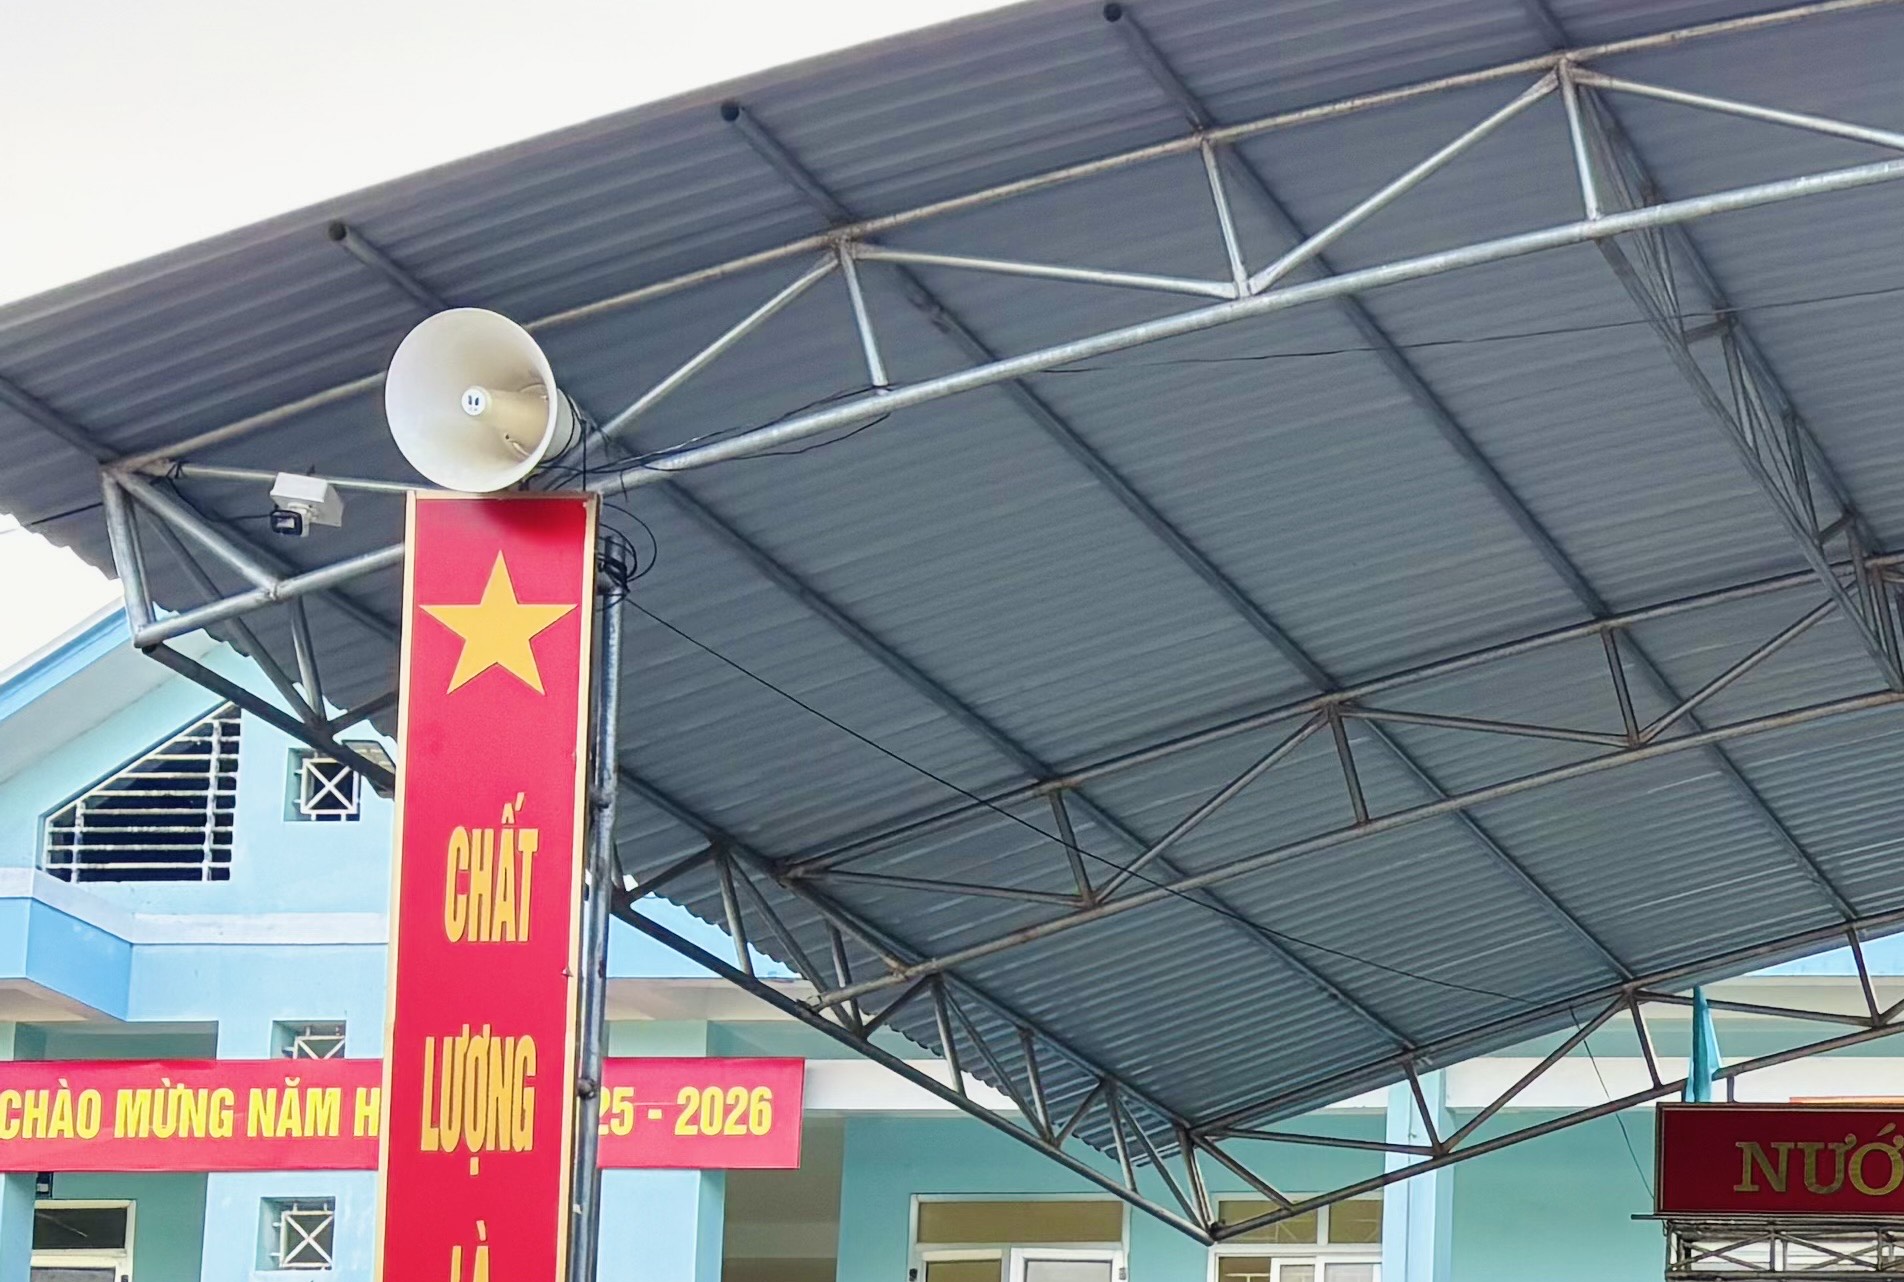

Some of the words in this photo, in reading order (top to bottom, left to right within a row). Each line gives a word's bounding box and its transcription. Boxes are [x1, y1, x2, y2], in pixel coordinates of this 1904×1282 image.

[444, 791, 540, 943] CHẤT
[0, 1078, 102, 1140] CHÀO
[113, 1077, 235, 1139] MỪNG
[246, 1076, 342, 1137] NĂM
[420, 1022, 537, 1176] LƯỢNG
[674, 1085, 773, 1136] 2026
